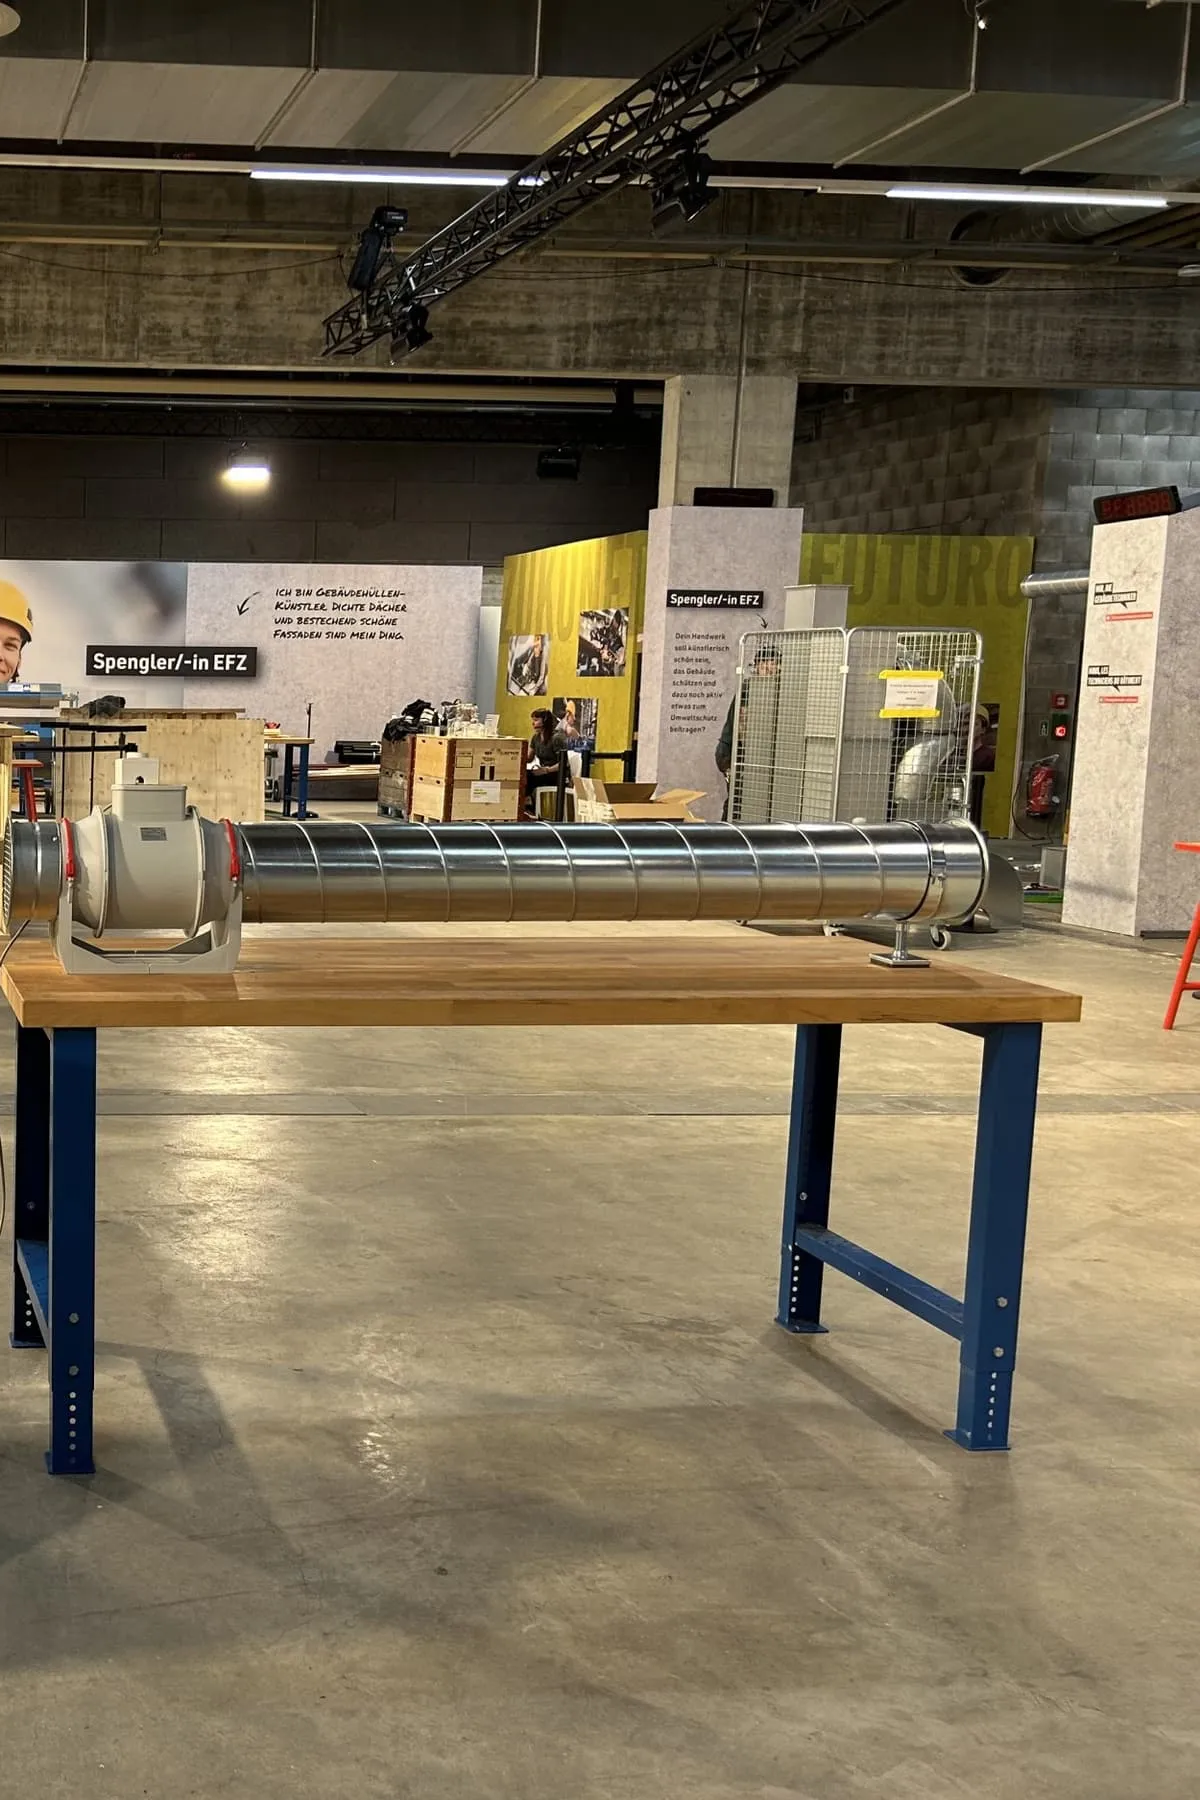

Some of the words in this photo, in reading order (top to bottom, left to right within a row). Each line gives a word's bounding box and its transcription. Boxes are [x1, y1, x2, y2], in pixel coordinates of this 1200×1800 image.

[275, 588, 292, 597] ICH
[295, 589, 313, 597] BIN
[316, 586, 406, 598] GEBÄUDEHÜLLEN-
[670, 593, 737, 607] Spengler/-in
[740, 595, 760, 606] EFZ
[332, 602, 366, 612] DICHTE
[369, 601, 407, 612] DÄCHER
[274, 617, 293, 625] UND
[296, 617, 357, 626] BESTECHEND
[360, 615, 398, 626] SCHÖNE
[273, 629, 322, 639] FASSADEN
[325, 631, 346, 639] SIND
[350, 631, 376, 640] MEIN
[93, 653, 209, 675] Spengler/-in
[213, 655, 247, 671] EFZ
